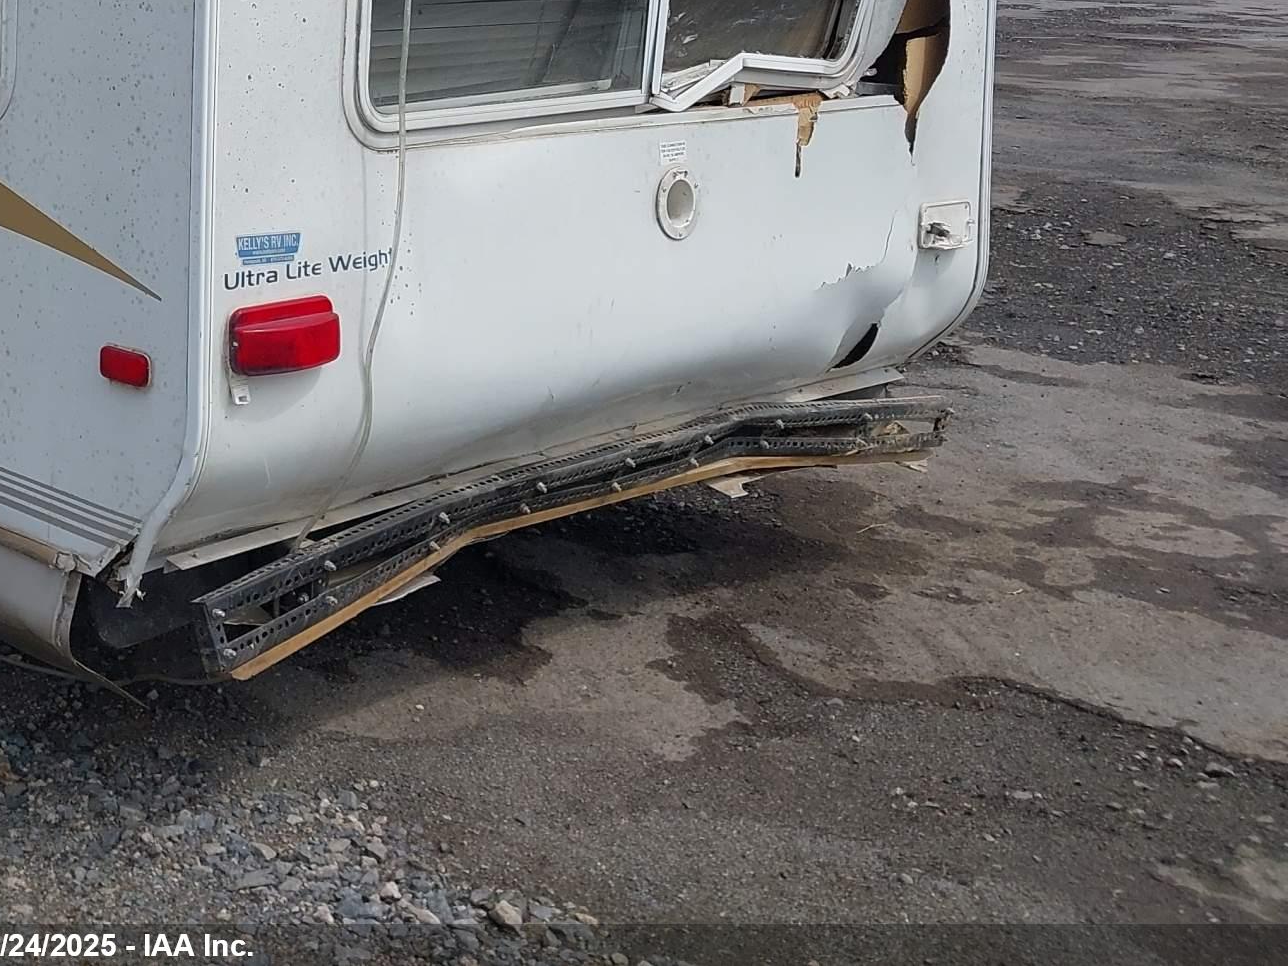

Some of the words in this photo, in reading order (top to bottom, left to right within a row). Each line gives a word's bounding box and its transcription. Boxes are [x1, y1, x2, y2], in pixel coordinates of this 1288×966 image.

[238, 236, 269, 251] KELLY'S
[271, 235, 282, 249] RV
[283, 233, 299, 248] INC.
[224, 272, 278, 291] Ultra
[286, 262, 322, 280] Lite
